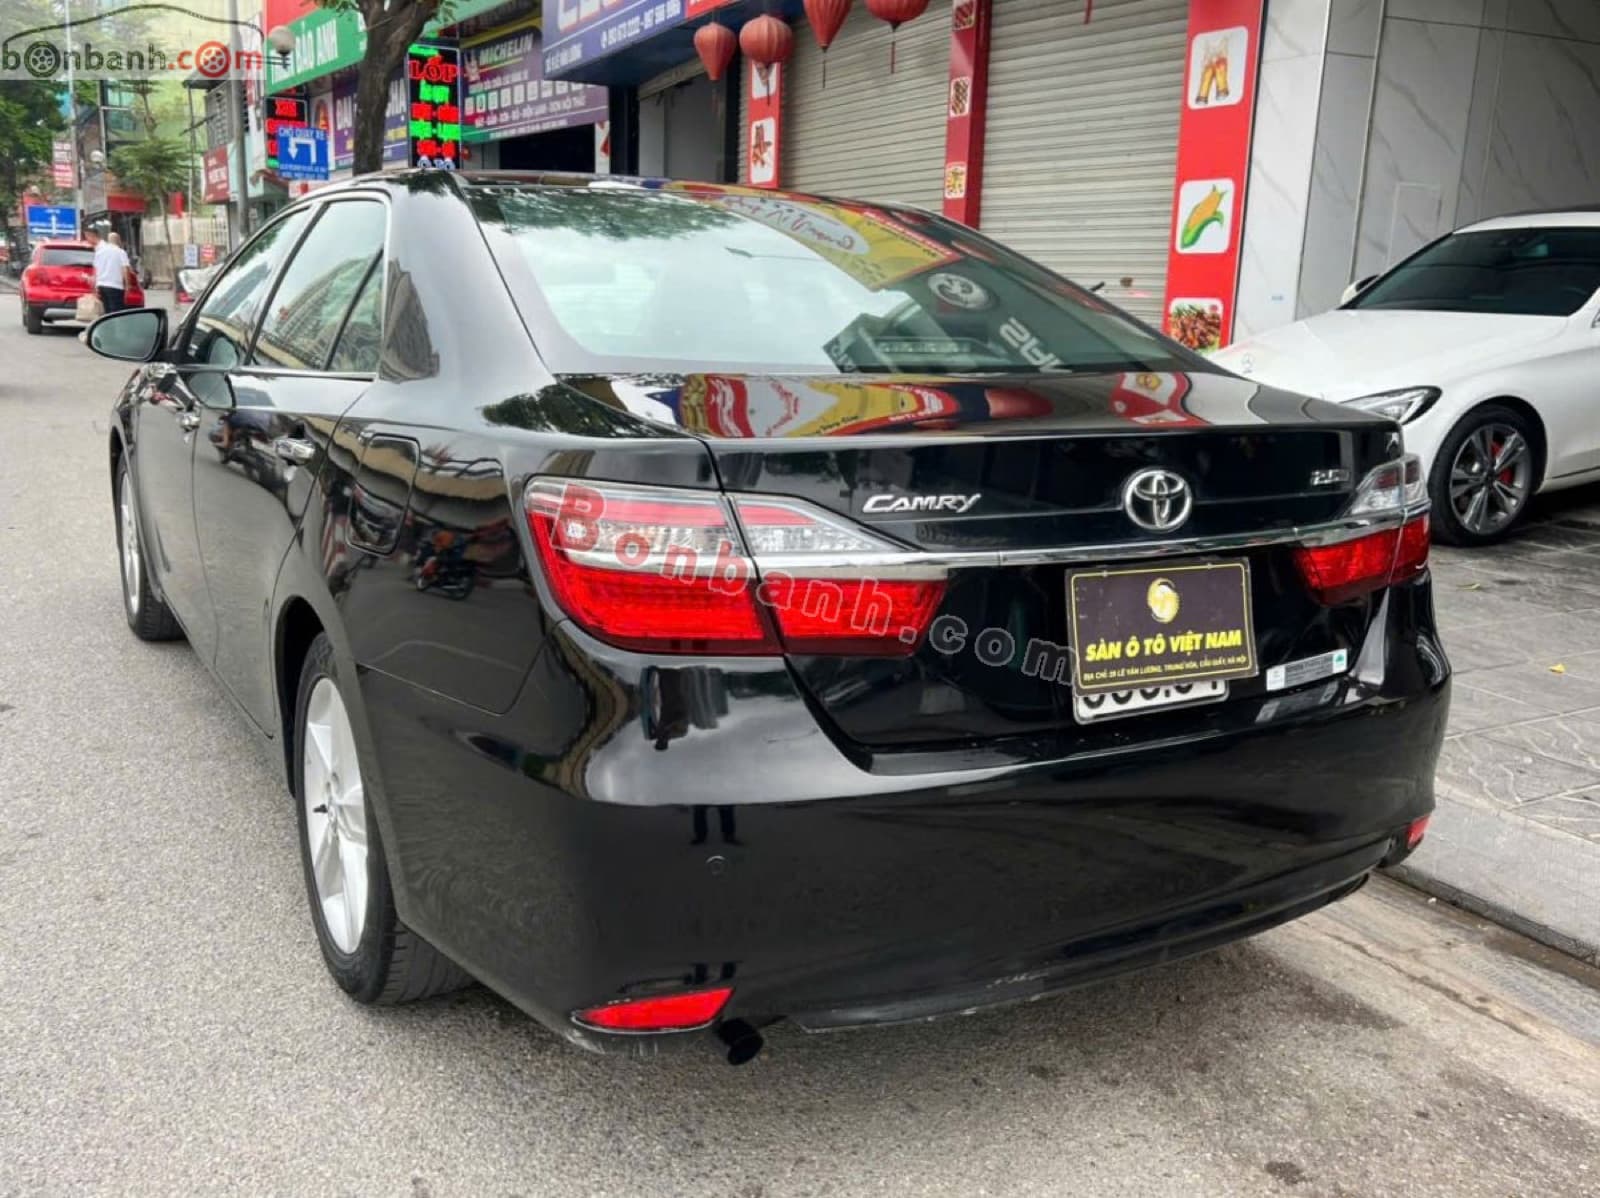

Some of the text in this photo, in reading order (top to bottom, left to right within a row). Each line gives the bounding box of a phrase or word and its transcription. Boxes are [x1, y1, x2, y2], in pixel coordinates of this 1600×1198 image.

[479, 33, 534, 66] MICHELIN
[408, 55, 459, 83] LỐP
[862, 493, 982, 513] CAMRY
[1085, 630, 1242, 662] SÀN Ô TÔ VIỆT NAM
